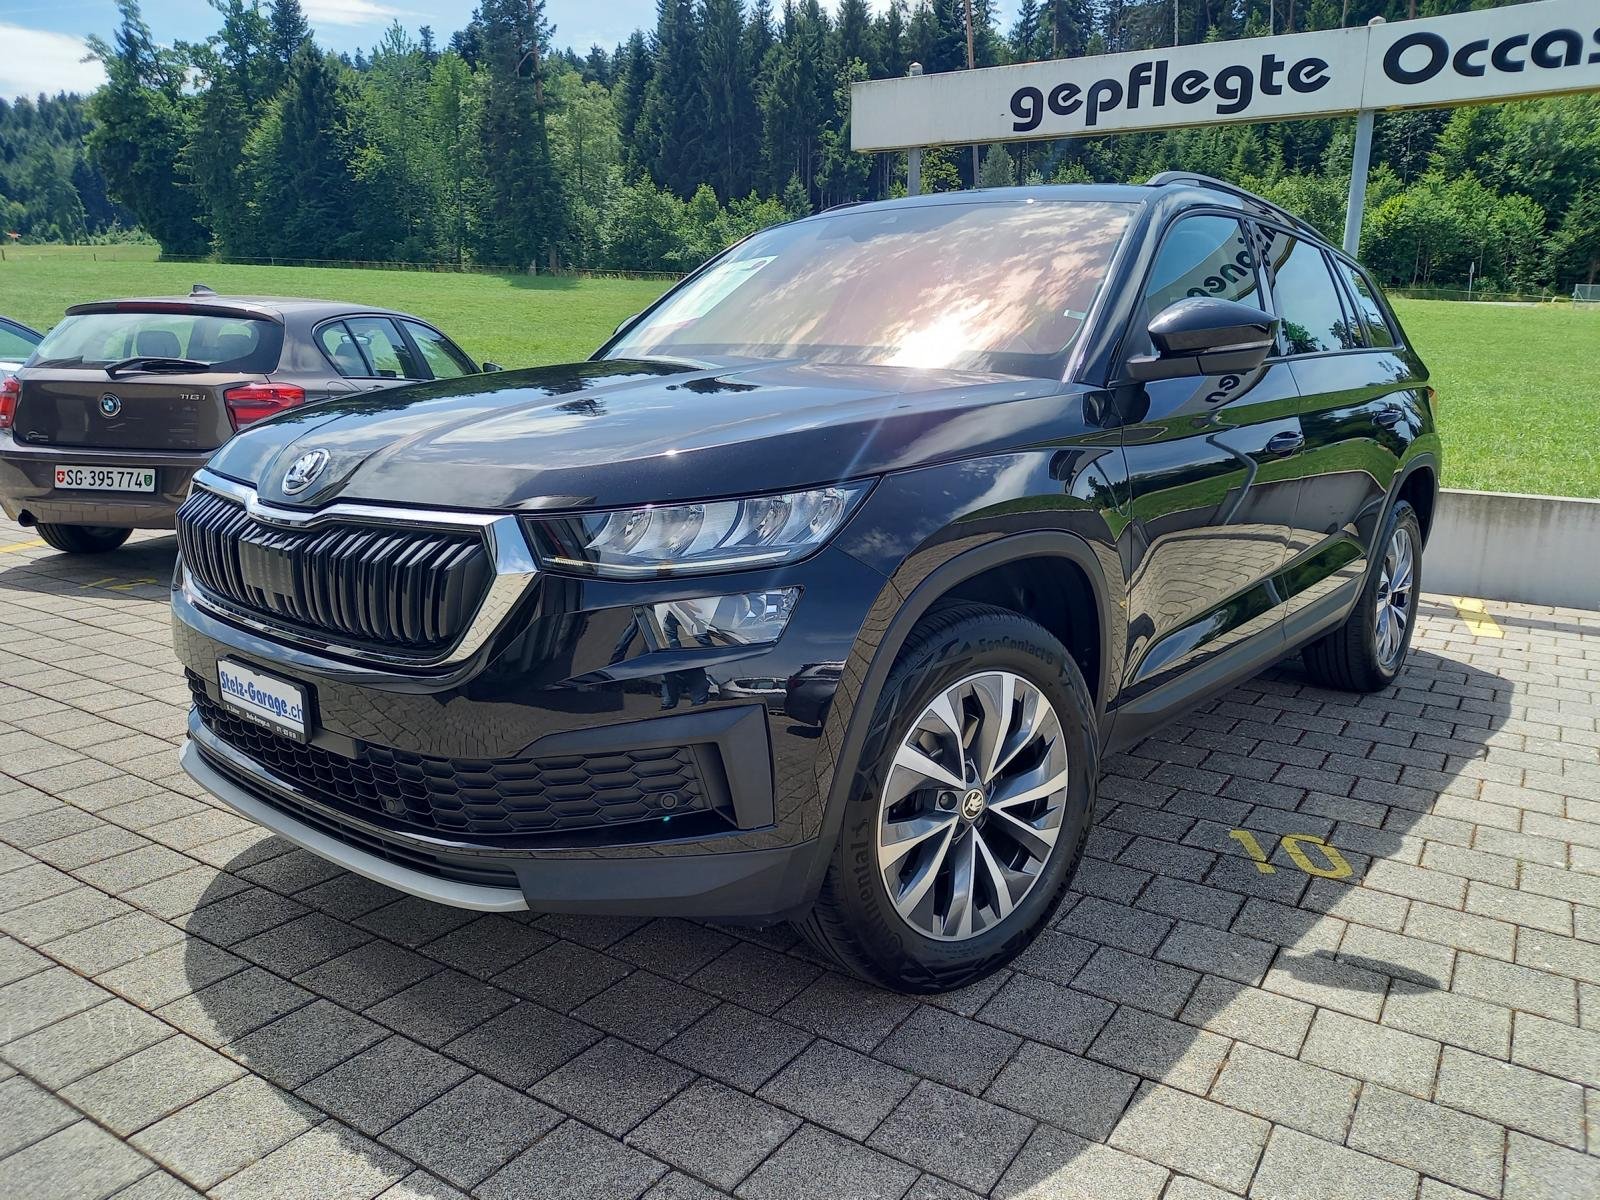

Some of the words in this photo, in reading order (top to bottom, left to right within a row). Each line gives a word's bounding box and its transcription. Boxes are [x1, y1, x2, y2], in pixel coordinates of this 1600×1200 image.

[1010, 53, 1331, 132] gepflegte
[220, 670, 303, 720] Stelz-Garage.ch
[1228, 828, 1354, 879] 10
